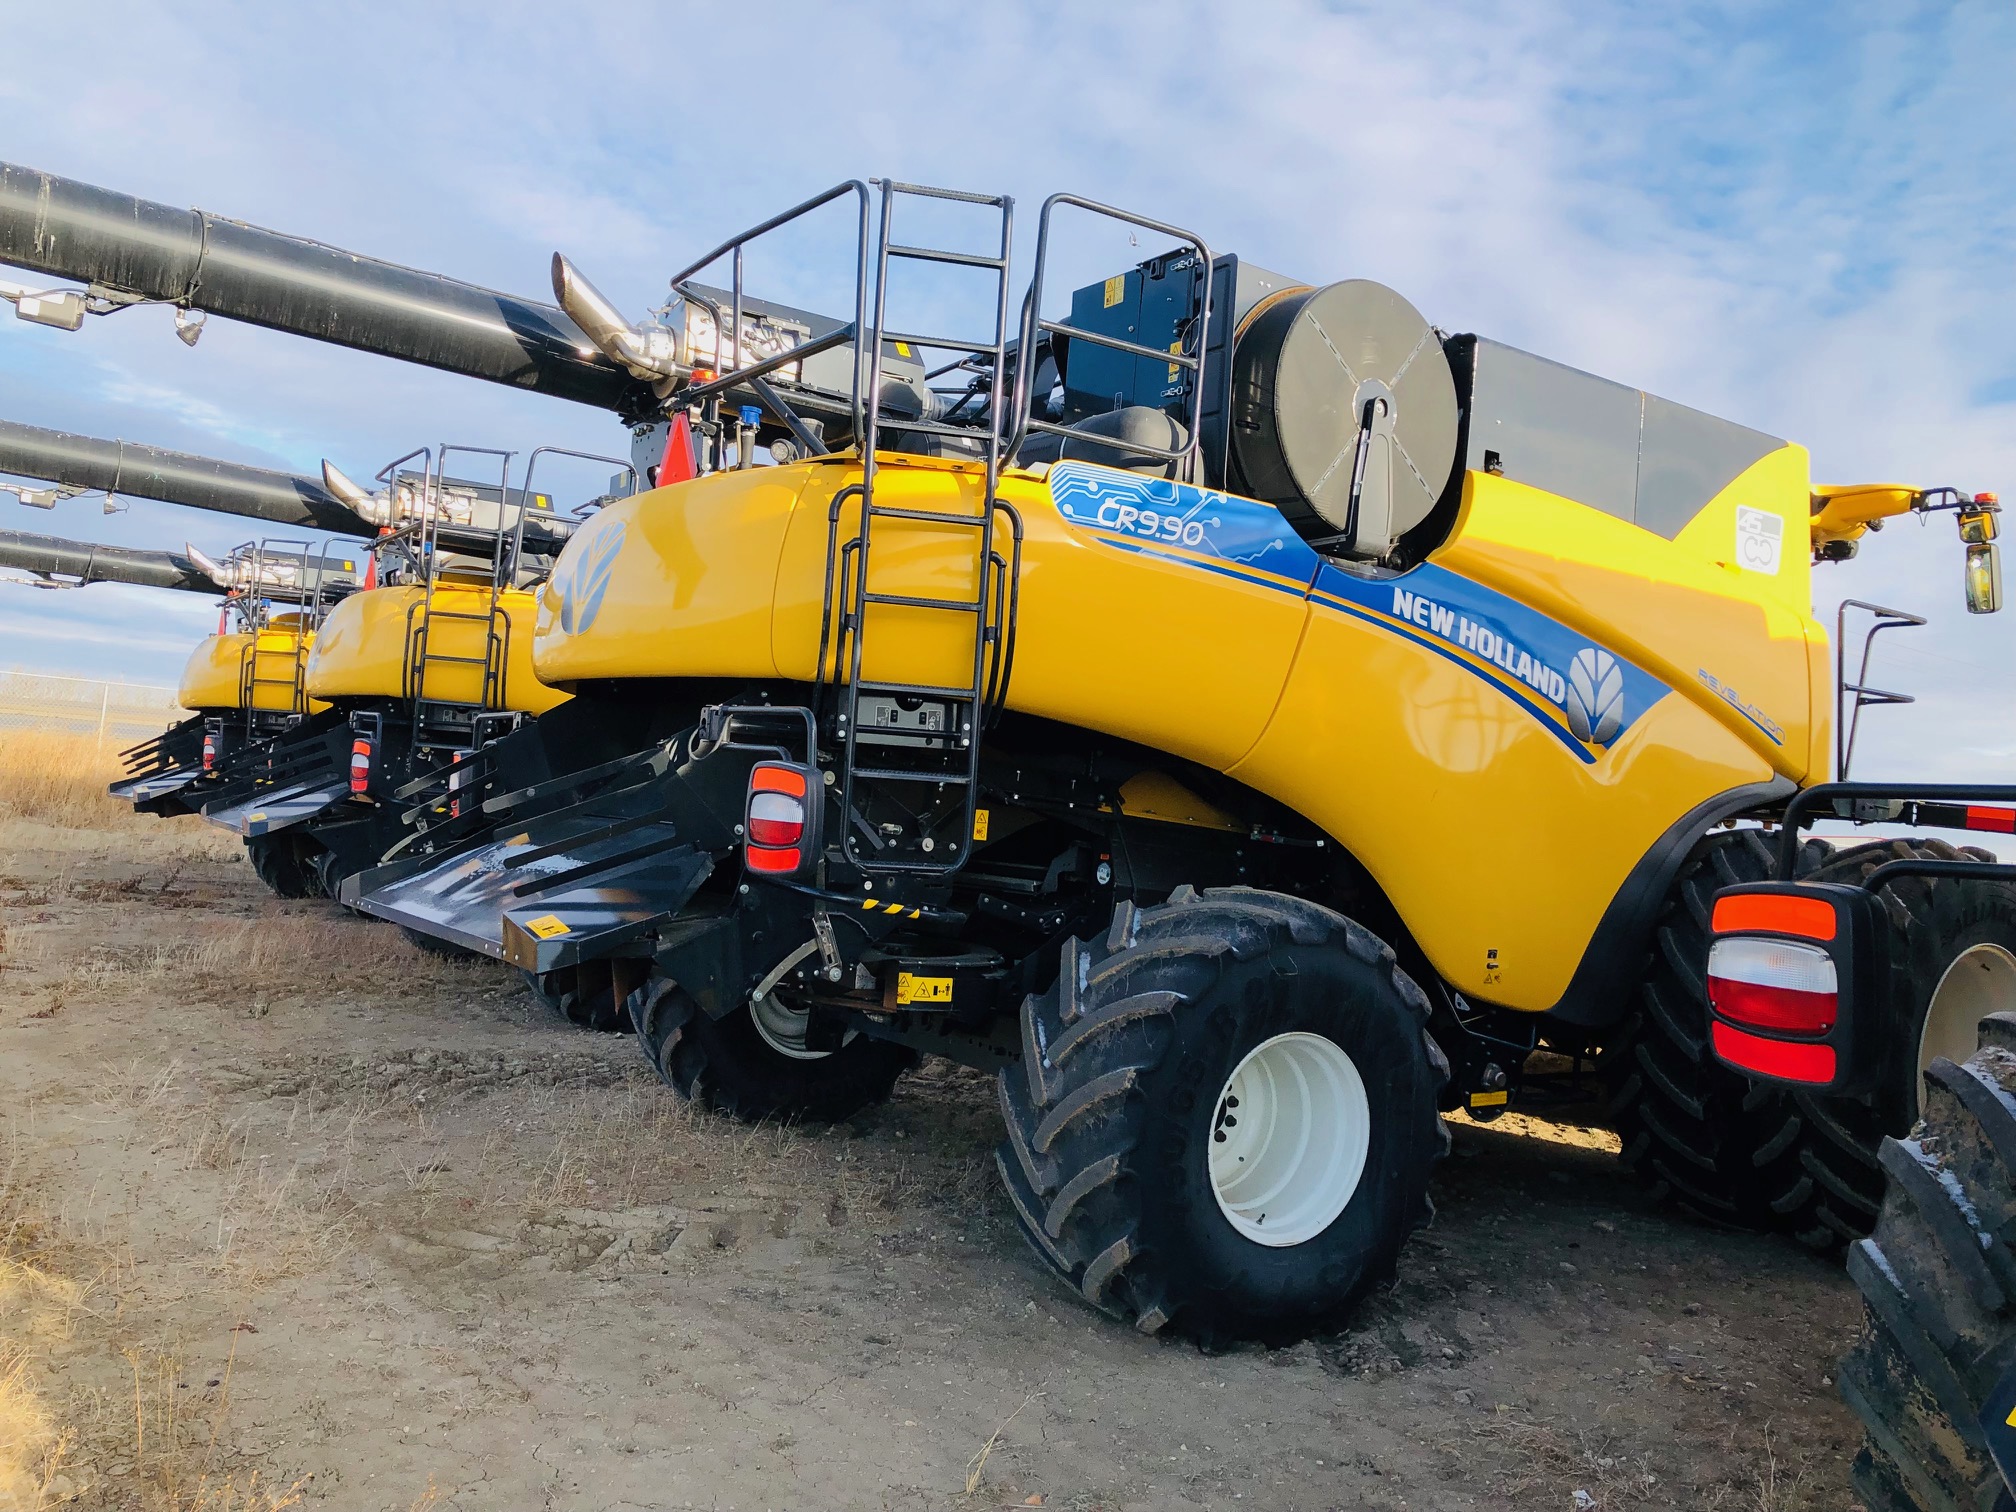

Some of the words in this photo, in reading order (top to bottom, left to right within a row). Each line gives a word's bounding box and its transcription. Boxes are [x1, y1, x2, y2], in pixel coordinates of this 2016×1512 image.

[1097, 502, 1204, 546] CR9.90
[1392, 586, 1455, 638] NEW
[1458, 616, 1566, 704] HOLLAND
[1698, 667, 1786, 742] REVELATION
